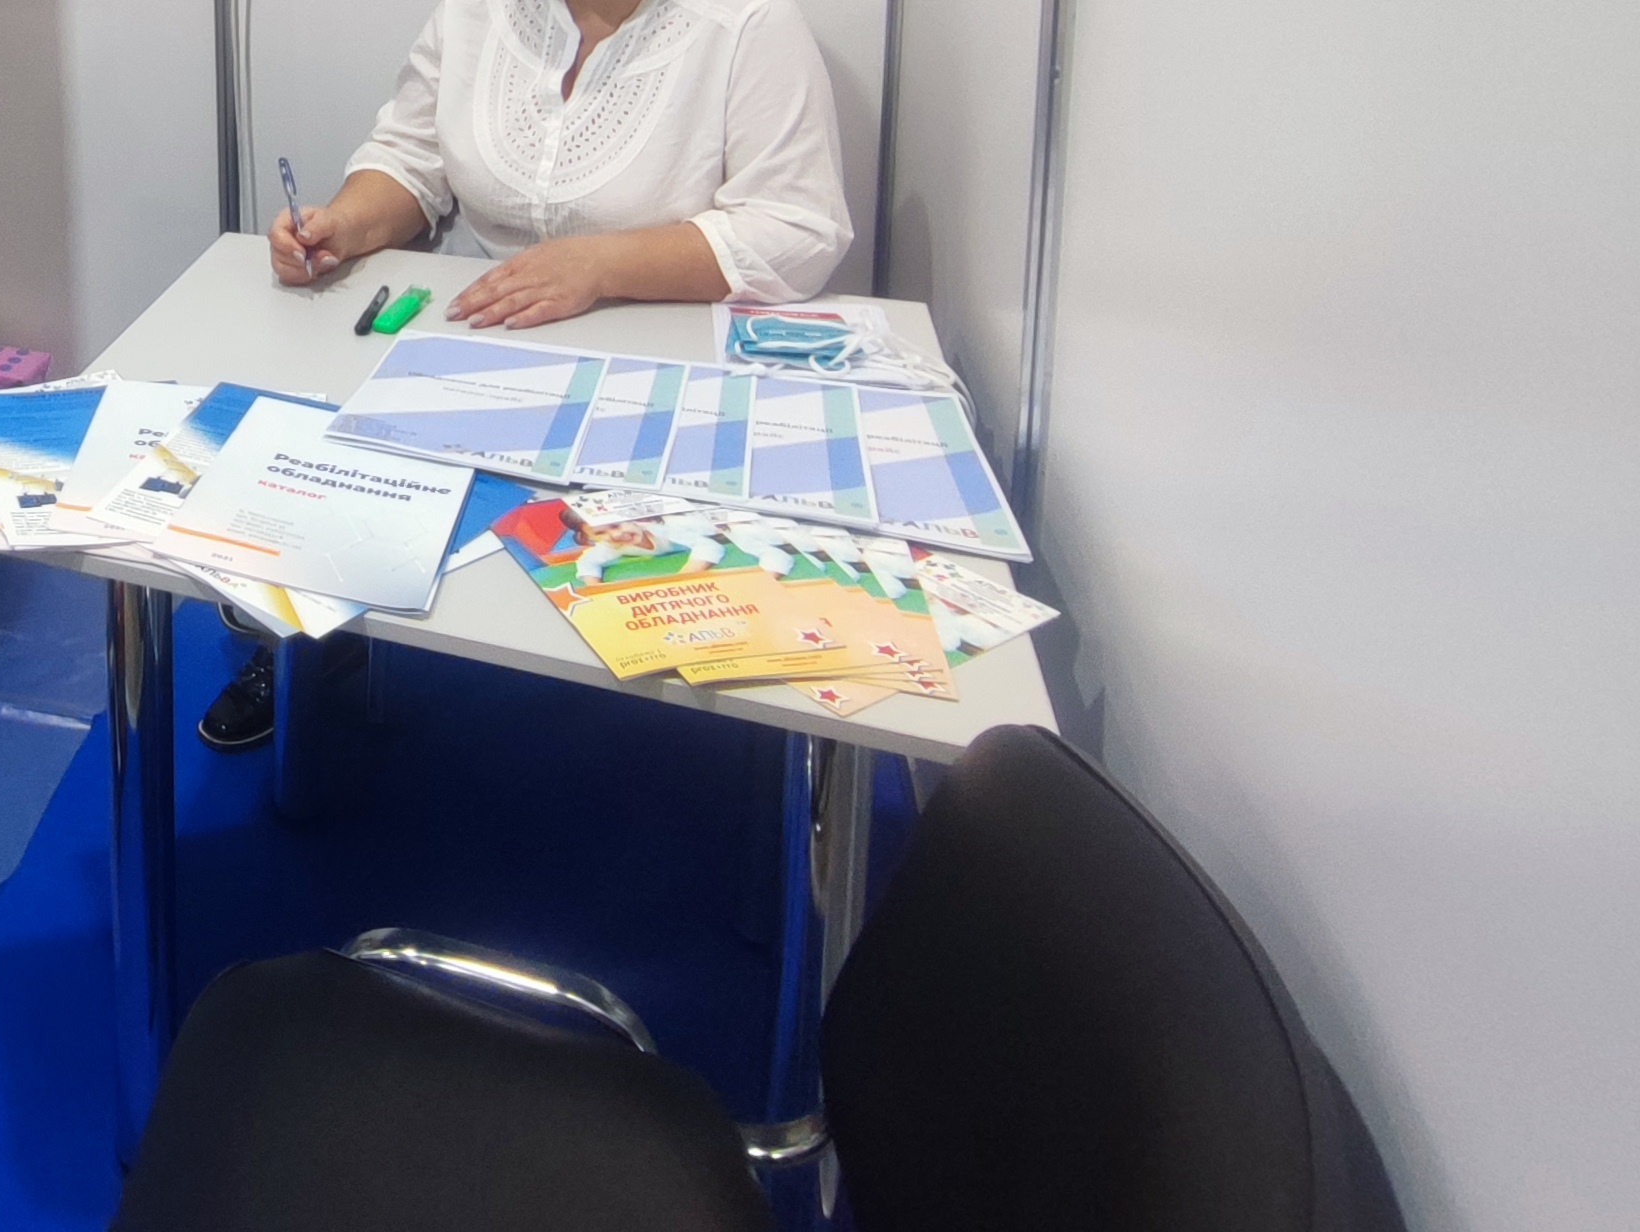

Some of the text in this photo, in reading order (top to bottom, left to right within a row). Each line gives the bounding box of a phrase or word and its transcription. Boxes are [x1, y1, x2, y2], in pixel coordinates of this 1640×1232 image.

[266, 465, 413, 502] обладнання
[273, 452, 452, 496] Реабілітаційне
[257, 478, 327, 501] каталог
[616, 581, 720, 605] ВИРОБНИК
[624, 604, 760, 631] ОБЛАДНАННЯ
[631, 594, 731, 619] ДИТЯЧОГО
